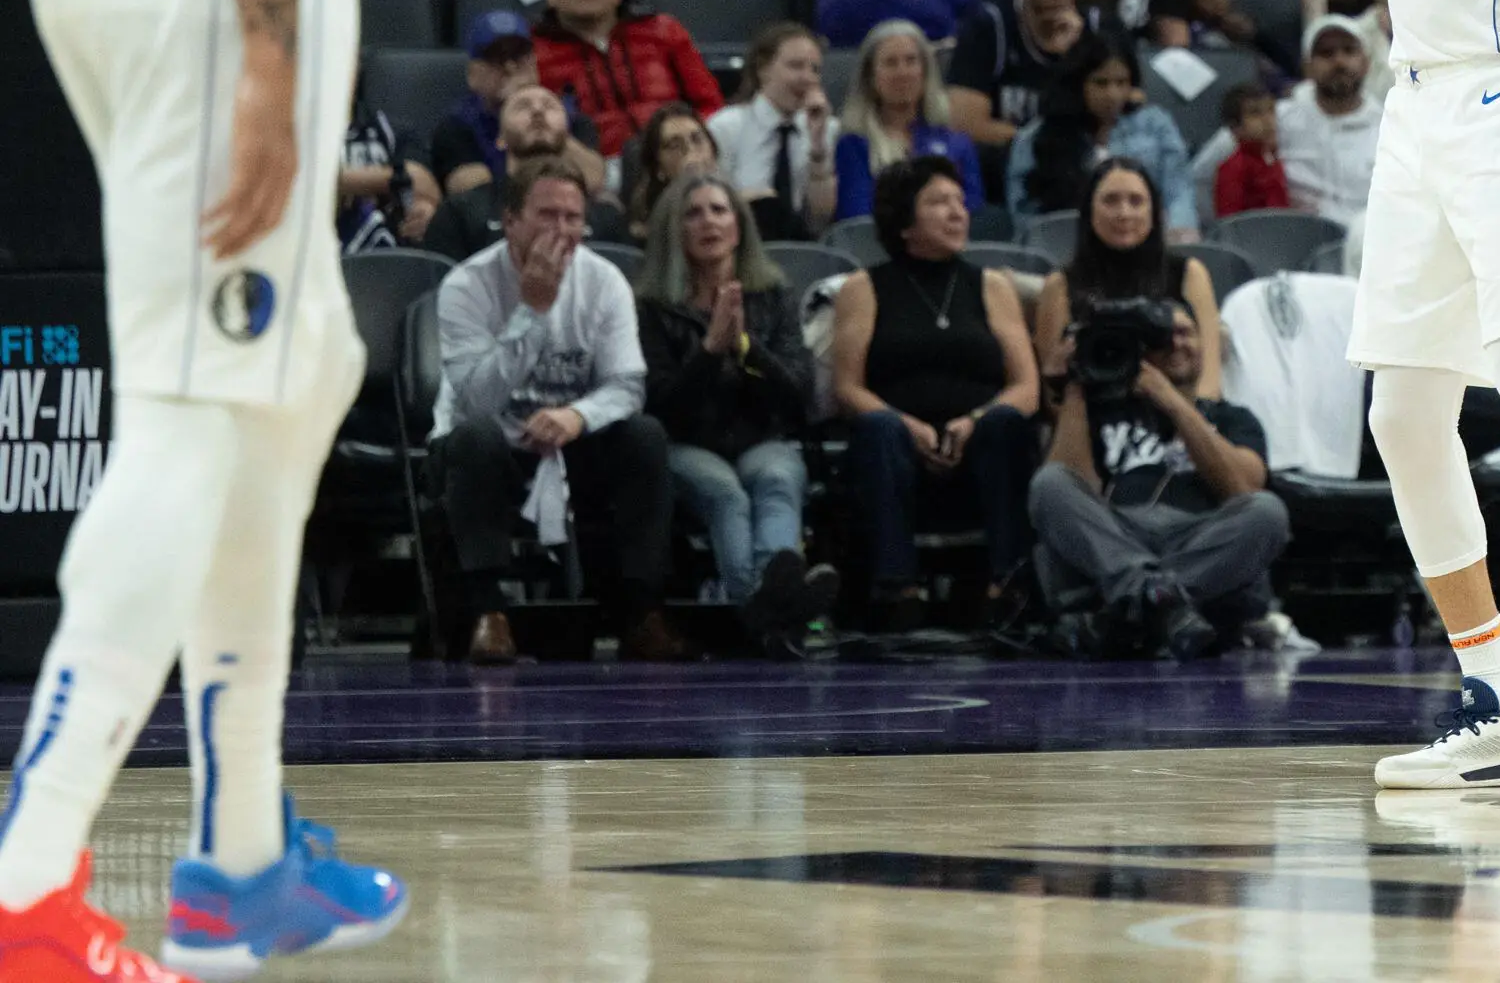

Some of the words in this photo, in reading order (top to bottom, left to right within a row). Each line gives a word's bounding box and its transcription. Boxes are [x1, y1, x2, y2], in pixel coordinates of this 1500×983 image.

[0, 326, 33, 365] Fi
[0, 368, 103, 440] AY-IN
[0, 440, 109, 513] URNA
